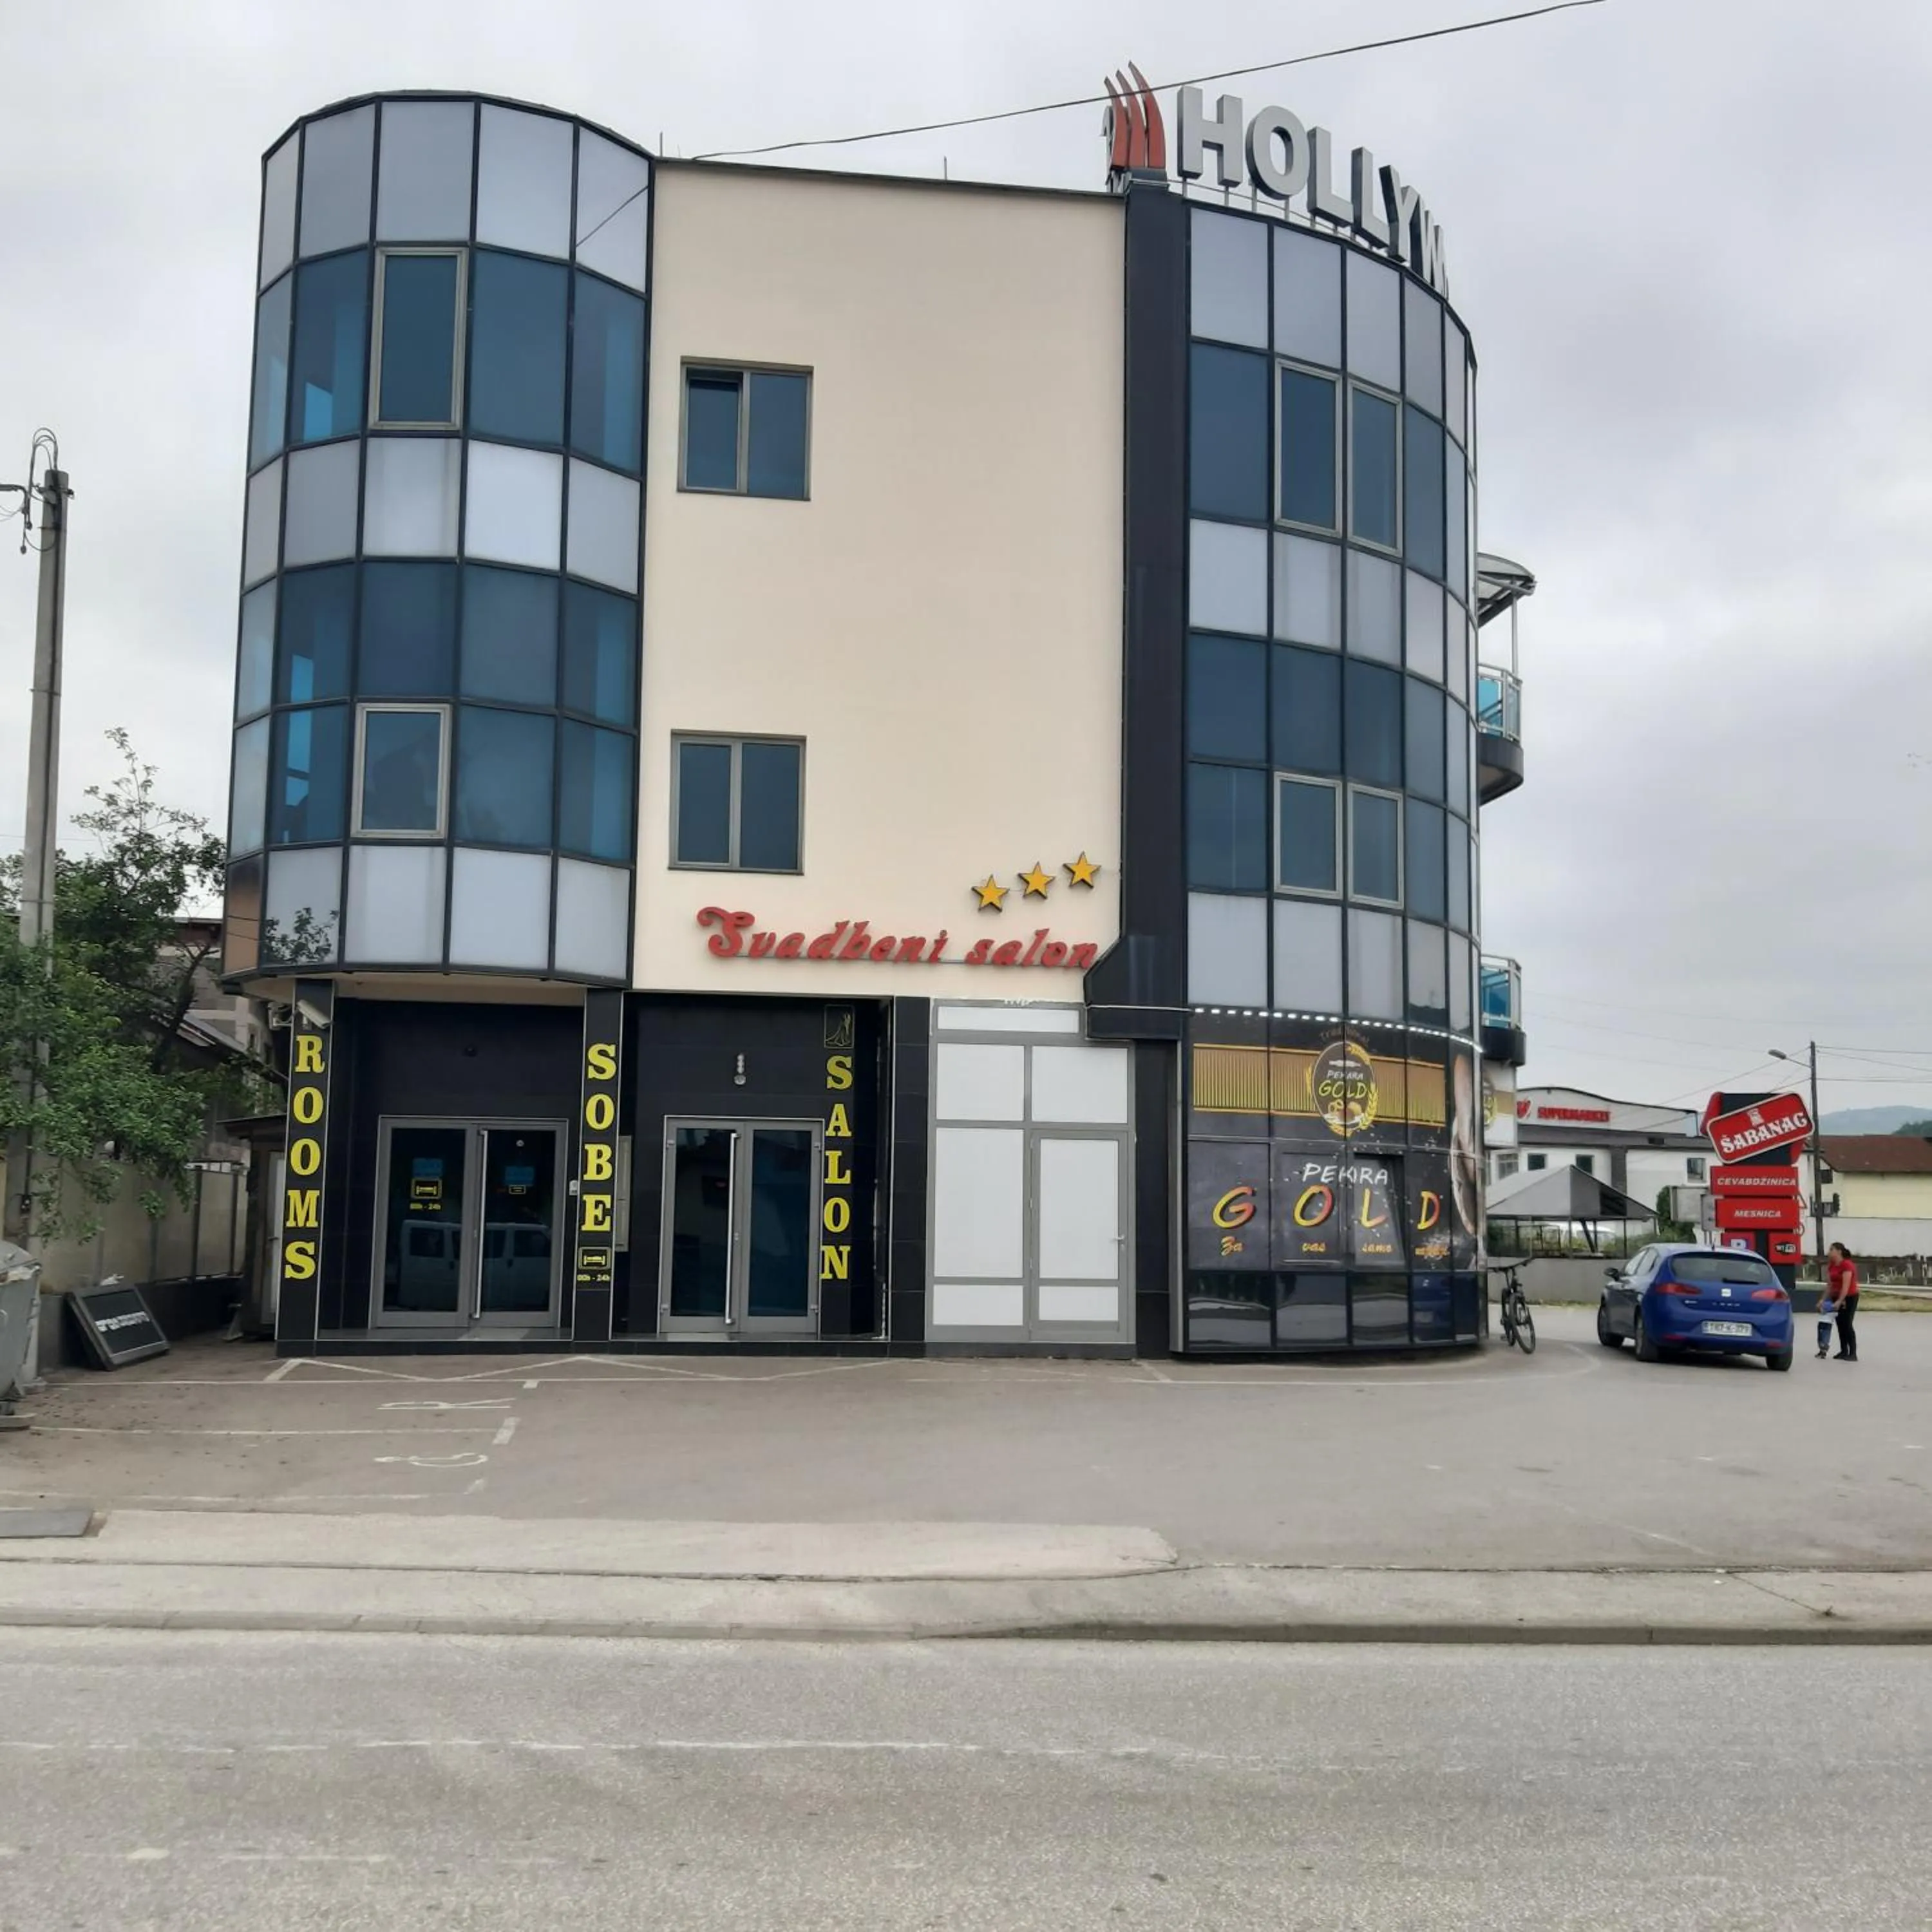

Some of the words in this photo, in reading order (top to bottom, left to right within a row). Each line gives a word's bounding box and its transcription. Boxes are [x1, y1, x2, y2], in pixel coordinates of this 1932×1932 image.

[1177, 85, 1448, 301] HOLLYW
[697, 906, 949, 964] Svadbeni
[966, 929, 1099, 970] salon
[582, 1044, 617, 1232] SOBE
[1318, 1080, 1368, 1099] GOLD
[285, 1035, 325, 1279] ROOMS
[820, 1056, 853, 1280] SALON
[1213, 1184, 1442, 1230] GOLD
[1734, 1209, 1781, 1218] MESNICA
